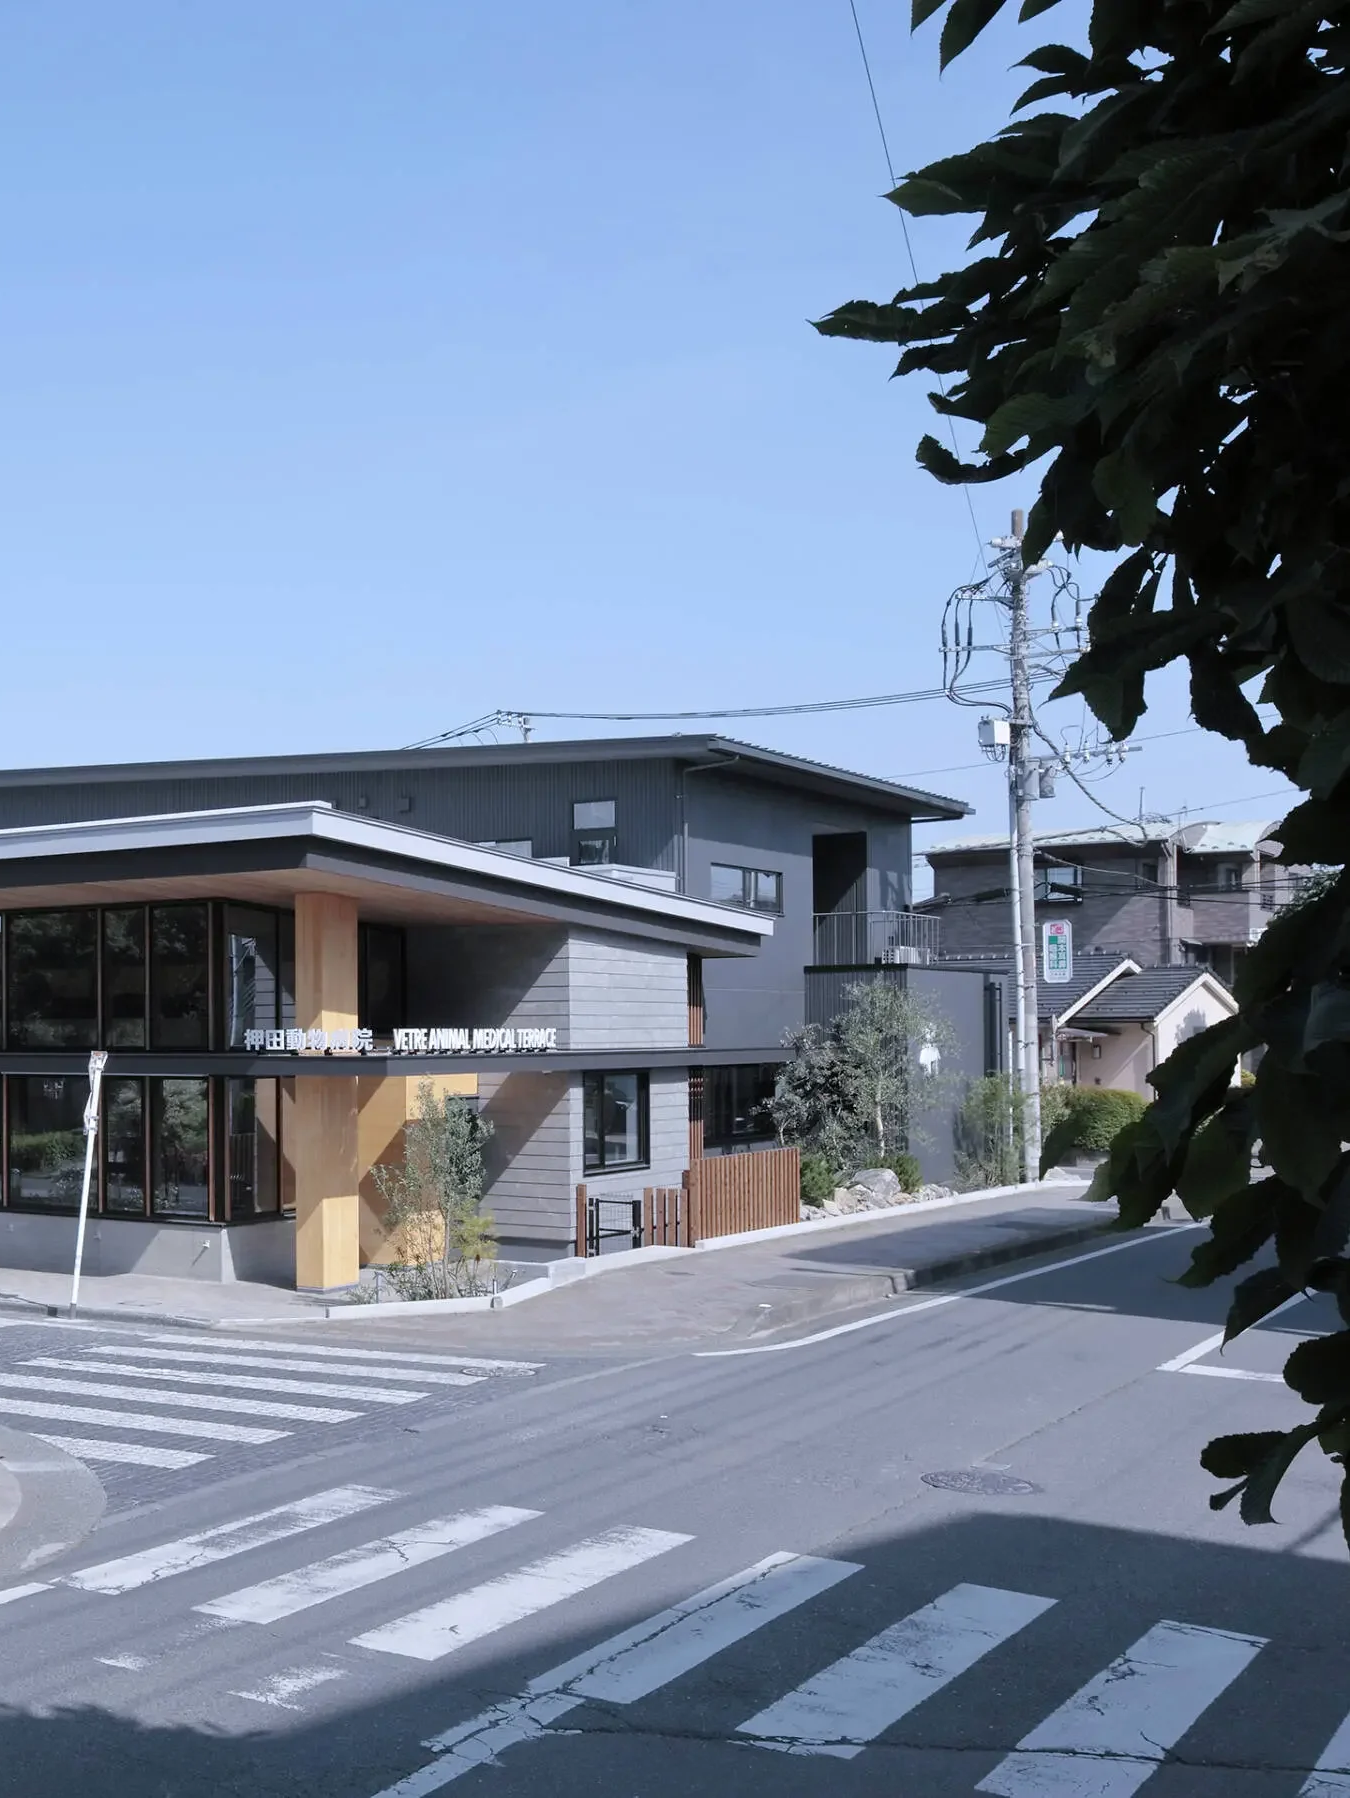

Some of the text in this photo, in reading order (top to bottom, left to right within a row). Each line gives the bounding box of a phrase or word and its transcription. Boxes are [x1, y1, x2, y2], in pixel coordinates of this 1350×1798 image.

[244, 1028, 373, 1051] 押田動物病院
[393, 1028, 557, 1050] VETRE ANIMAL MEDICAL TERRACE
